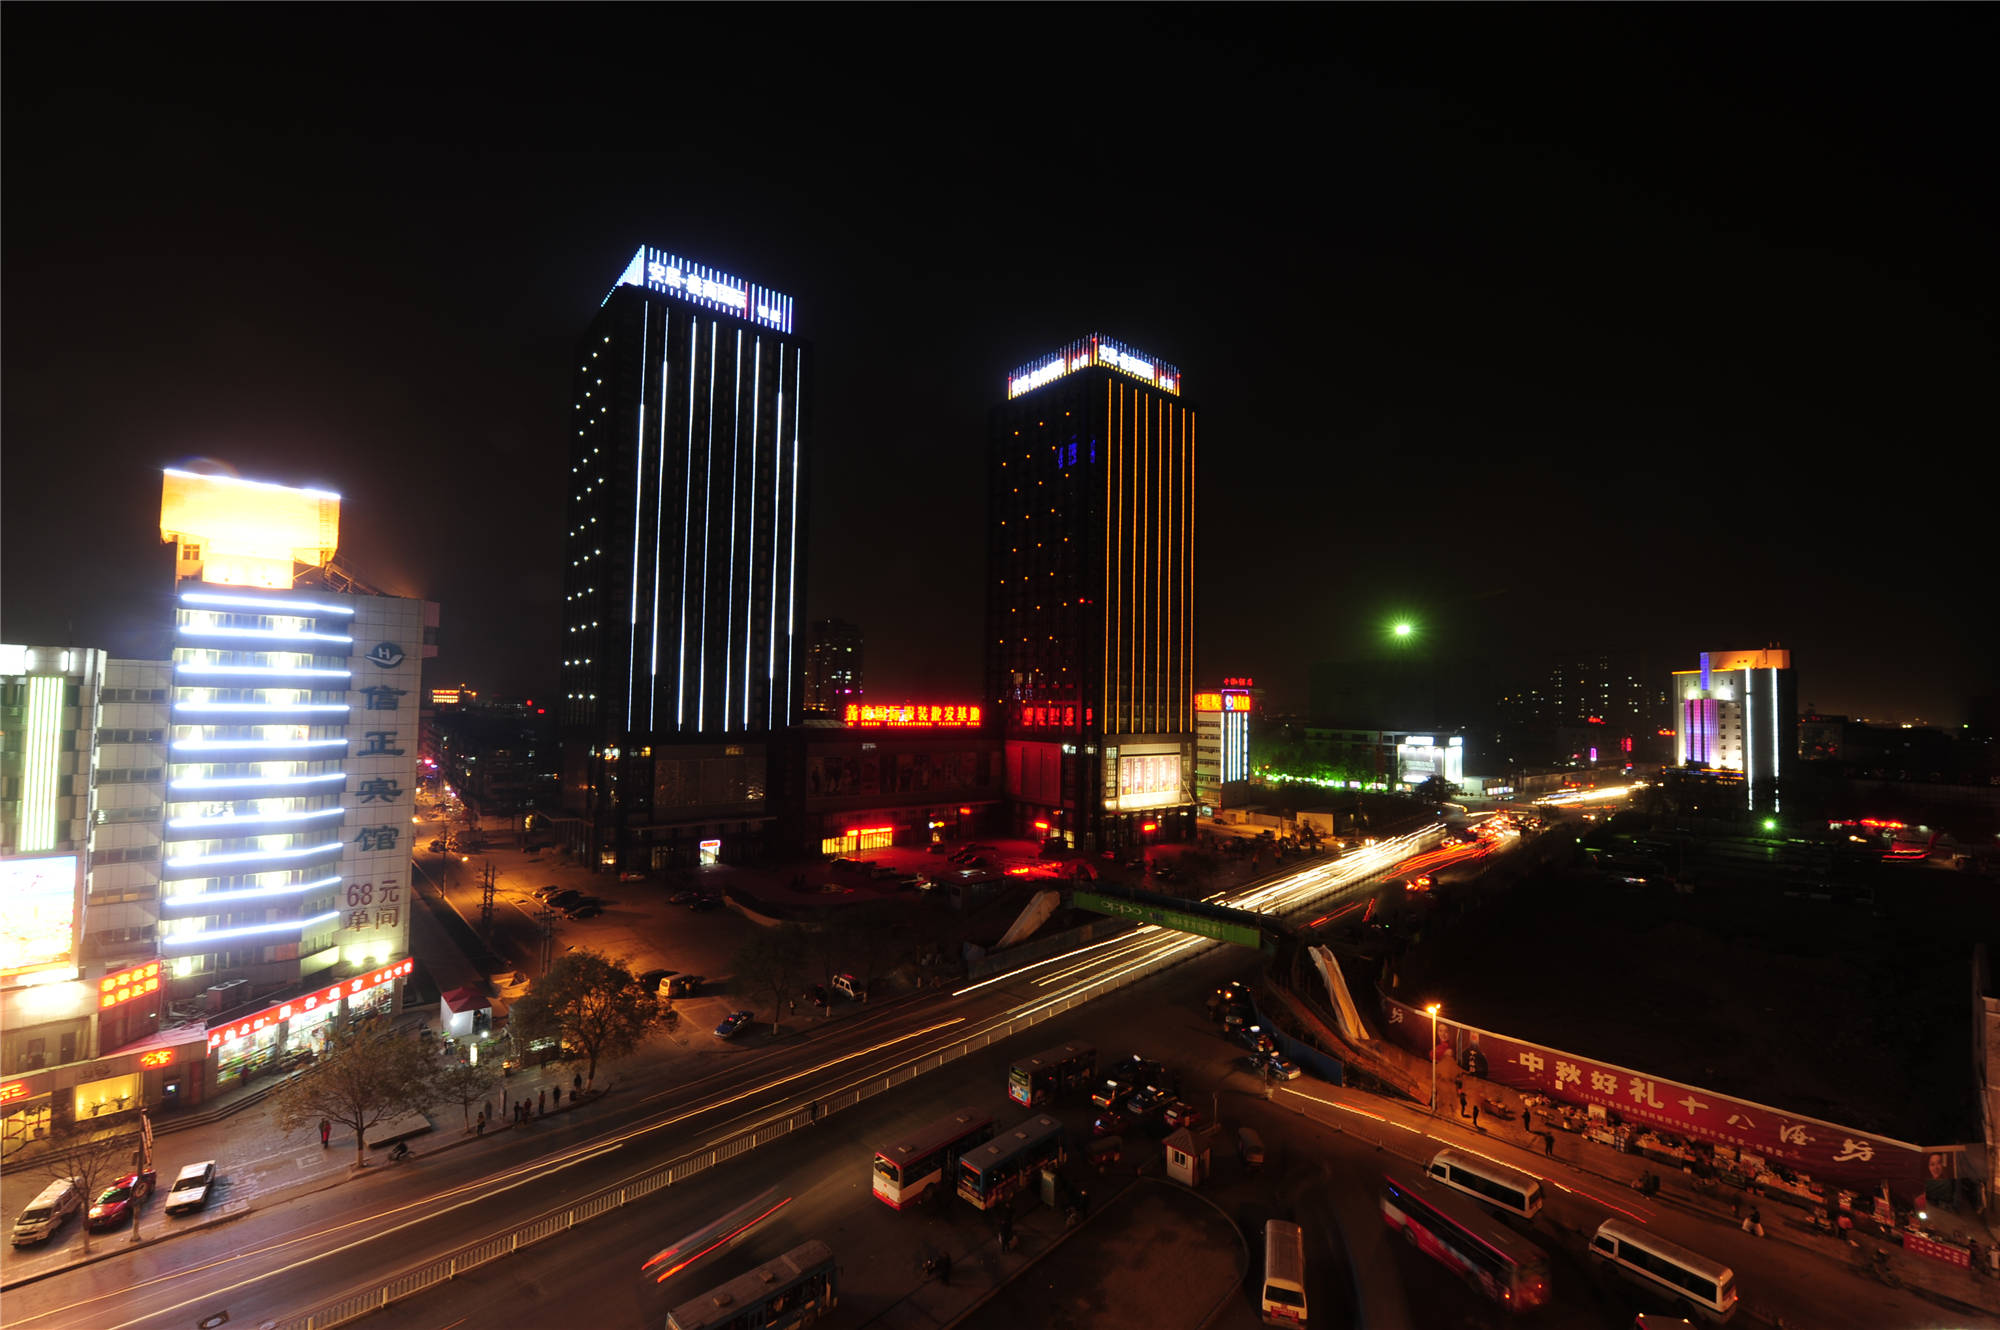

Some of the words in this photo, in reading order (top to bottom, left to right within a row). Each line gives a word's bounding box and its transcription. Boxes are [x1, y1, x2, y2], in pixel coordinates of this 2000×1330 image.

[354, 685, 408, 852] 信正宾馆
[347, 880, 400, 908] 68元
[345, 907, 399, 933] 单间
